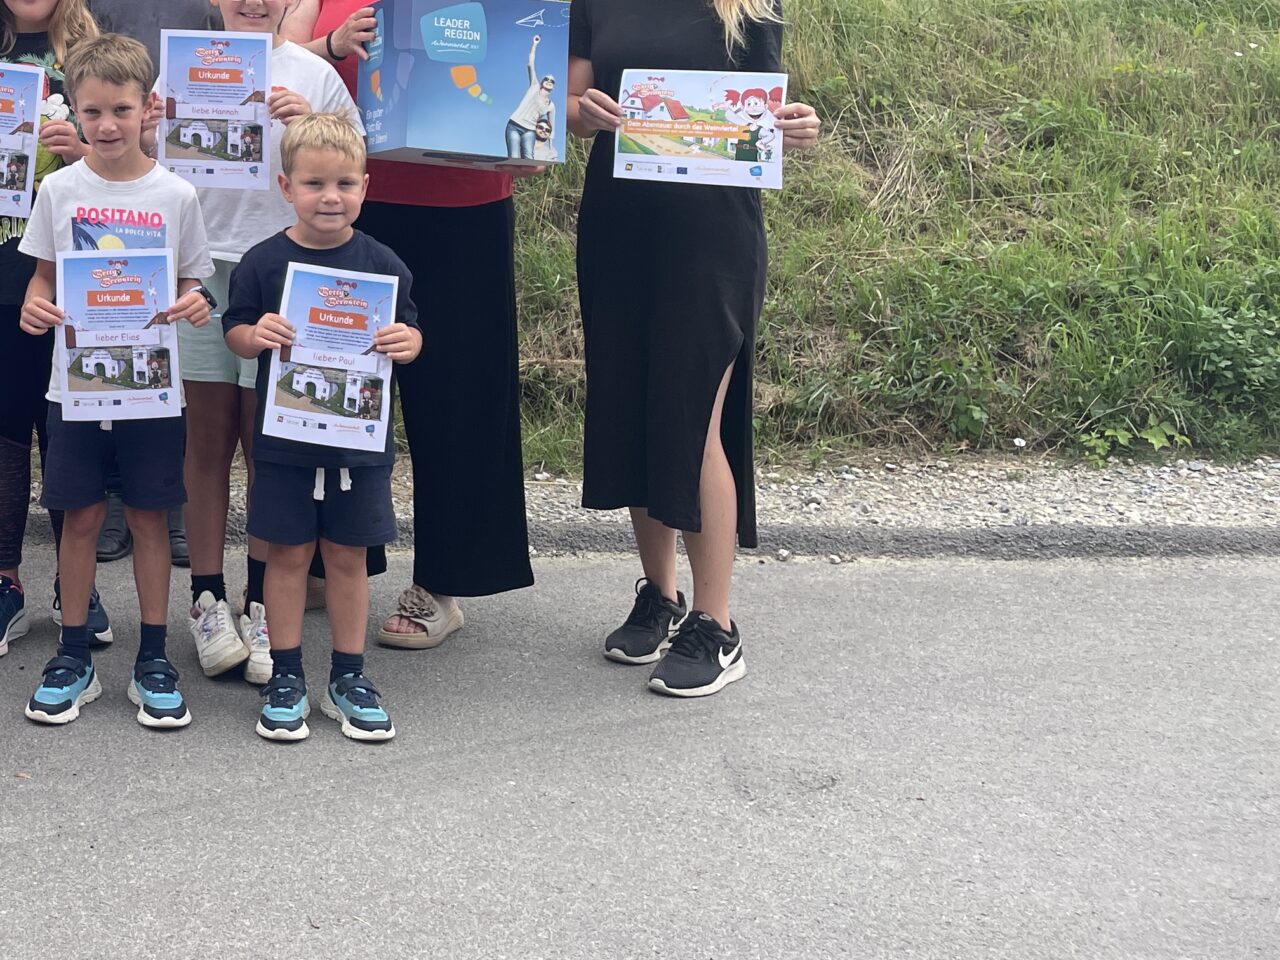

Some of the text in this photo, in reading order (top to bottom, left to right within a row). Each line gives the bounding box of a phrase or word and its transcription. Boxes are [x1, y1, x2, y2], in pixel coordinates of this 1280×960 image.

[434, 16, 470, 29] LEADER
[444, 28, 480, 40] REGION
[198, 71, 230, 80] Urkunde
[191, 106, 239, 115] liebe Hannah
[704, 124, 738, 132] Weinviertel
[76, 207, 163, 228] POSITANO
[124, 228, 145, 236] DOLCE
[96, 293, 131, 303] Urkunde
[319, 312, 354, 325] Urkunde
[96, 333, 140, 342] lieber Elias
[313, 352, 355, 365] lieber Paul
